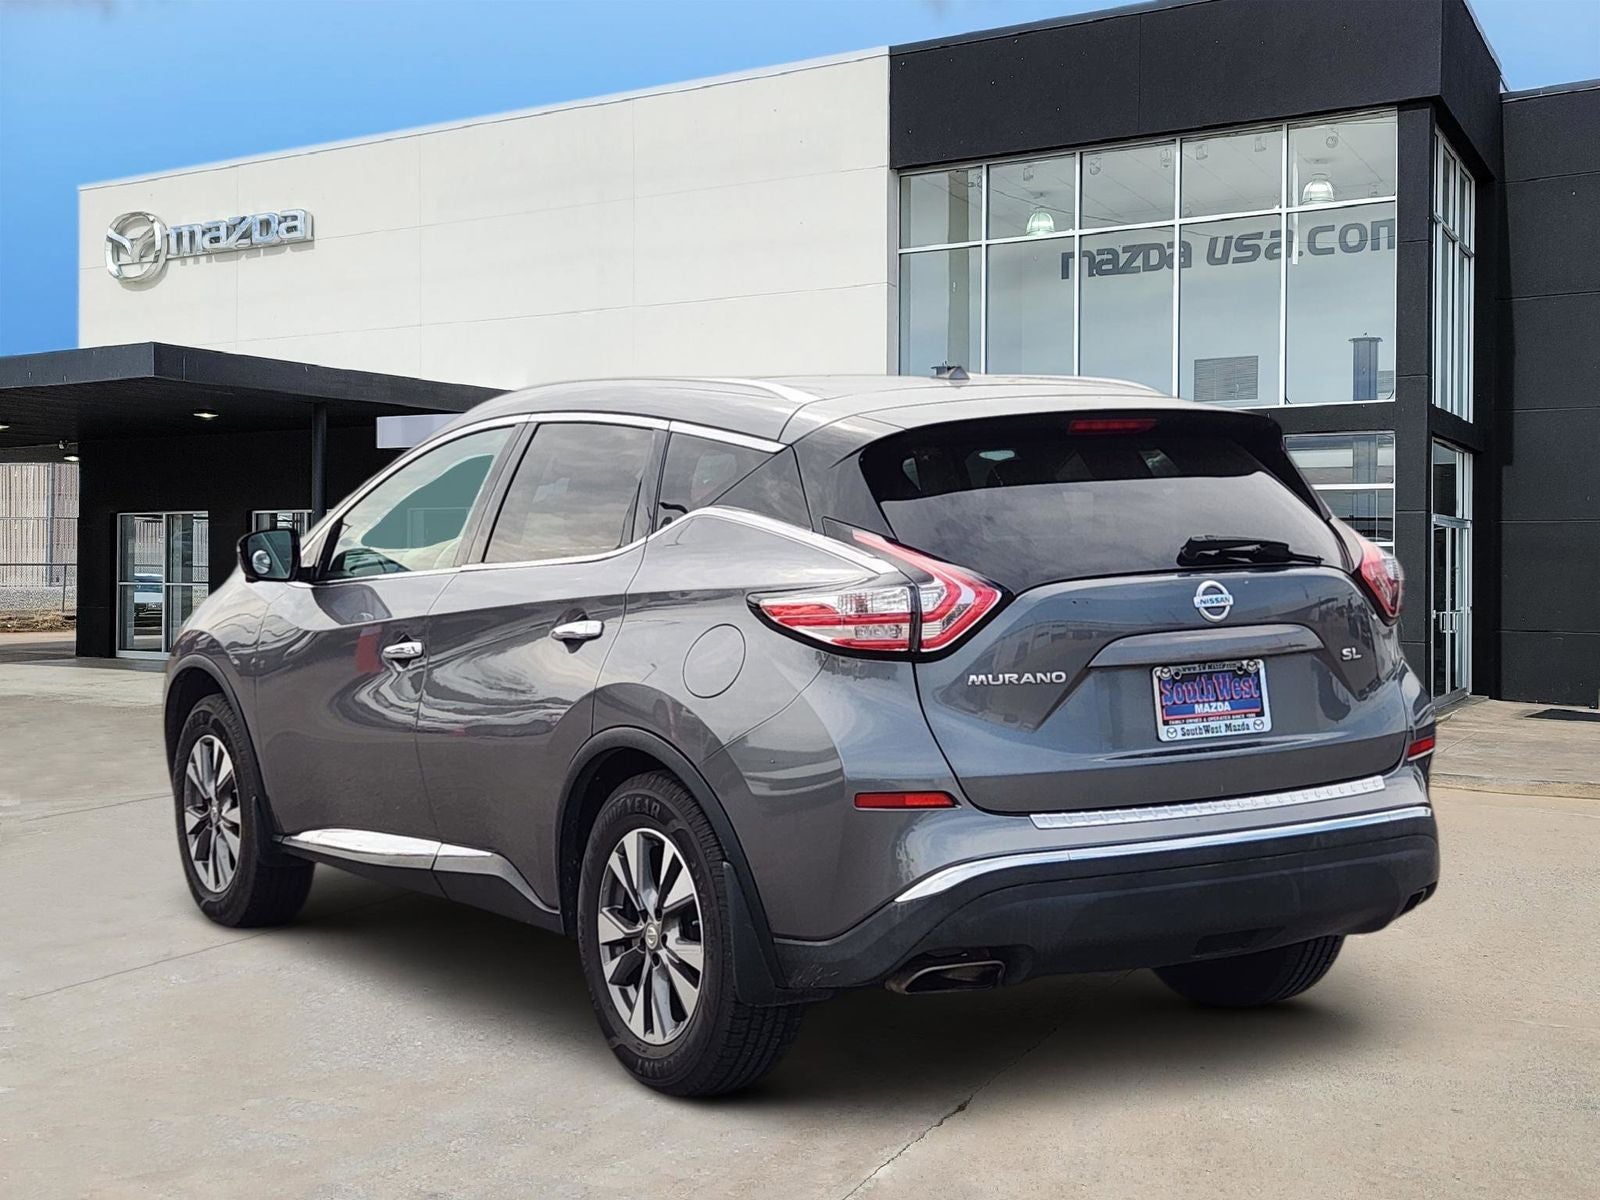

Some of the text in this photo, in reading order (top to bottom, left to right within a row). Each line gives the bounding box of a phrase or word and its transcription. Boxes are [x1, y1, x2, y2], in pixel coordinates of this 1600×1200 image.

[167, 208, 314, 256] mazda
[1061, 240, 1192, 279] mazda
[1200, 597, 1231, 605] NISSAN
[1342, 647, 1362, 660] SL
[967, 672, 1067, 686] MURANO
[1161, 673, 1260, 706] SouthWest
[1194, 701, 1231, 714] MAZDA
[1180, 722, 1251, 737] SouthWest Mazda
